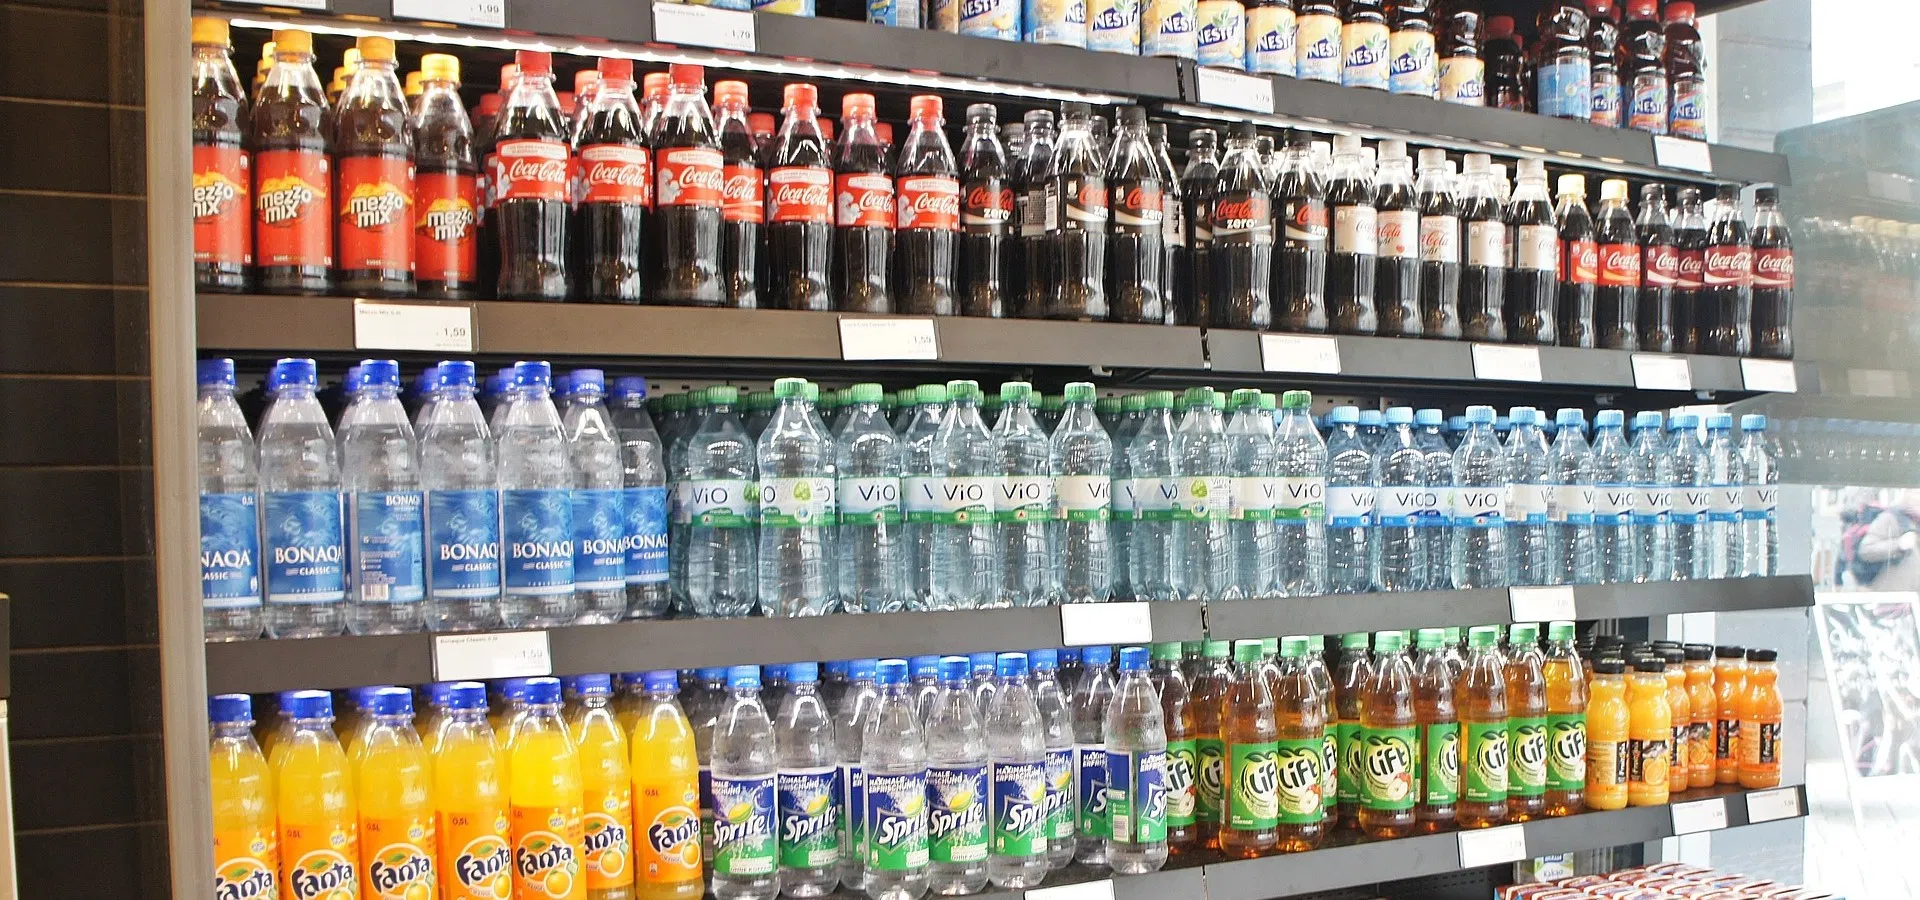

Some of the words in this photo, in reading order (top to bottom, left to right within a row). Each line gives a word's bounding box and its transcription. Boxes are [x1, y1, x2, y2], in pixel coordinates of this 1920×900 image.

[193, 181, 234, 202] ezzo
[260, 185, 312, 210] mezzo
[266, 201, 297, 224] mix
[351, 192, 404, 214] mezzo
[358, 208, 391, 228] mix
[428, 208, 474, 227] mezzo
[984, 208, 1011, 221] zero
[1227, 218, 1256, 229] zero
[435, 223, 466, 241] mix
[202, 571, 229, 581] ASSIC
[299, 566, 331, 576] CLASSIC
[465, 563, 493, 572] CLASSIC
[535, 561, 564, 570] CLASSIC
[713, 810, 765, 849] Sprite
[784, 805, 837, 843] Sprite
[929, 802, 983, 838] Sprite
[649, 816, 699, 853] Fanta
[456, 847, 510, 886] Fanta
[516, 844, 572, 878] Fanta
[291, 862, 352, 900] Fanta
[371, 855, 430, 893] Fanta
